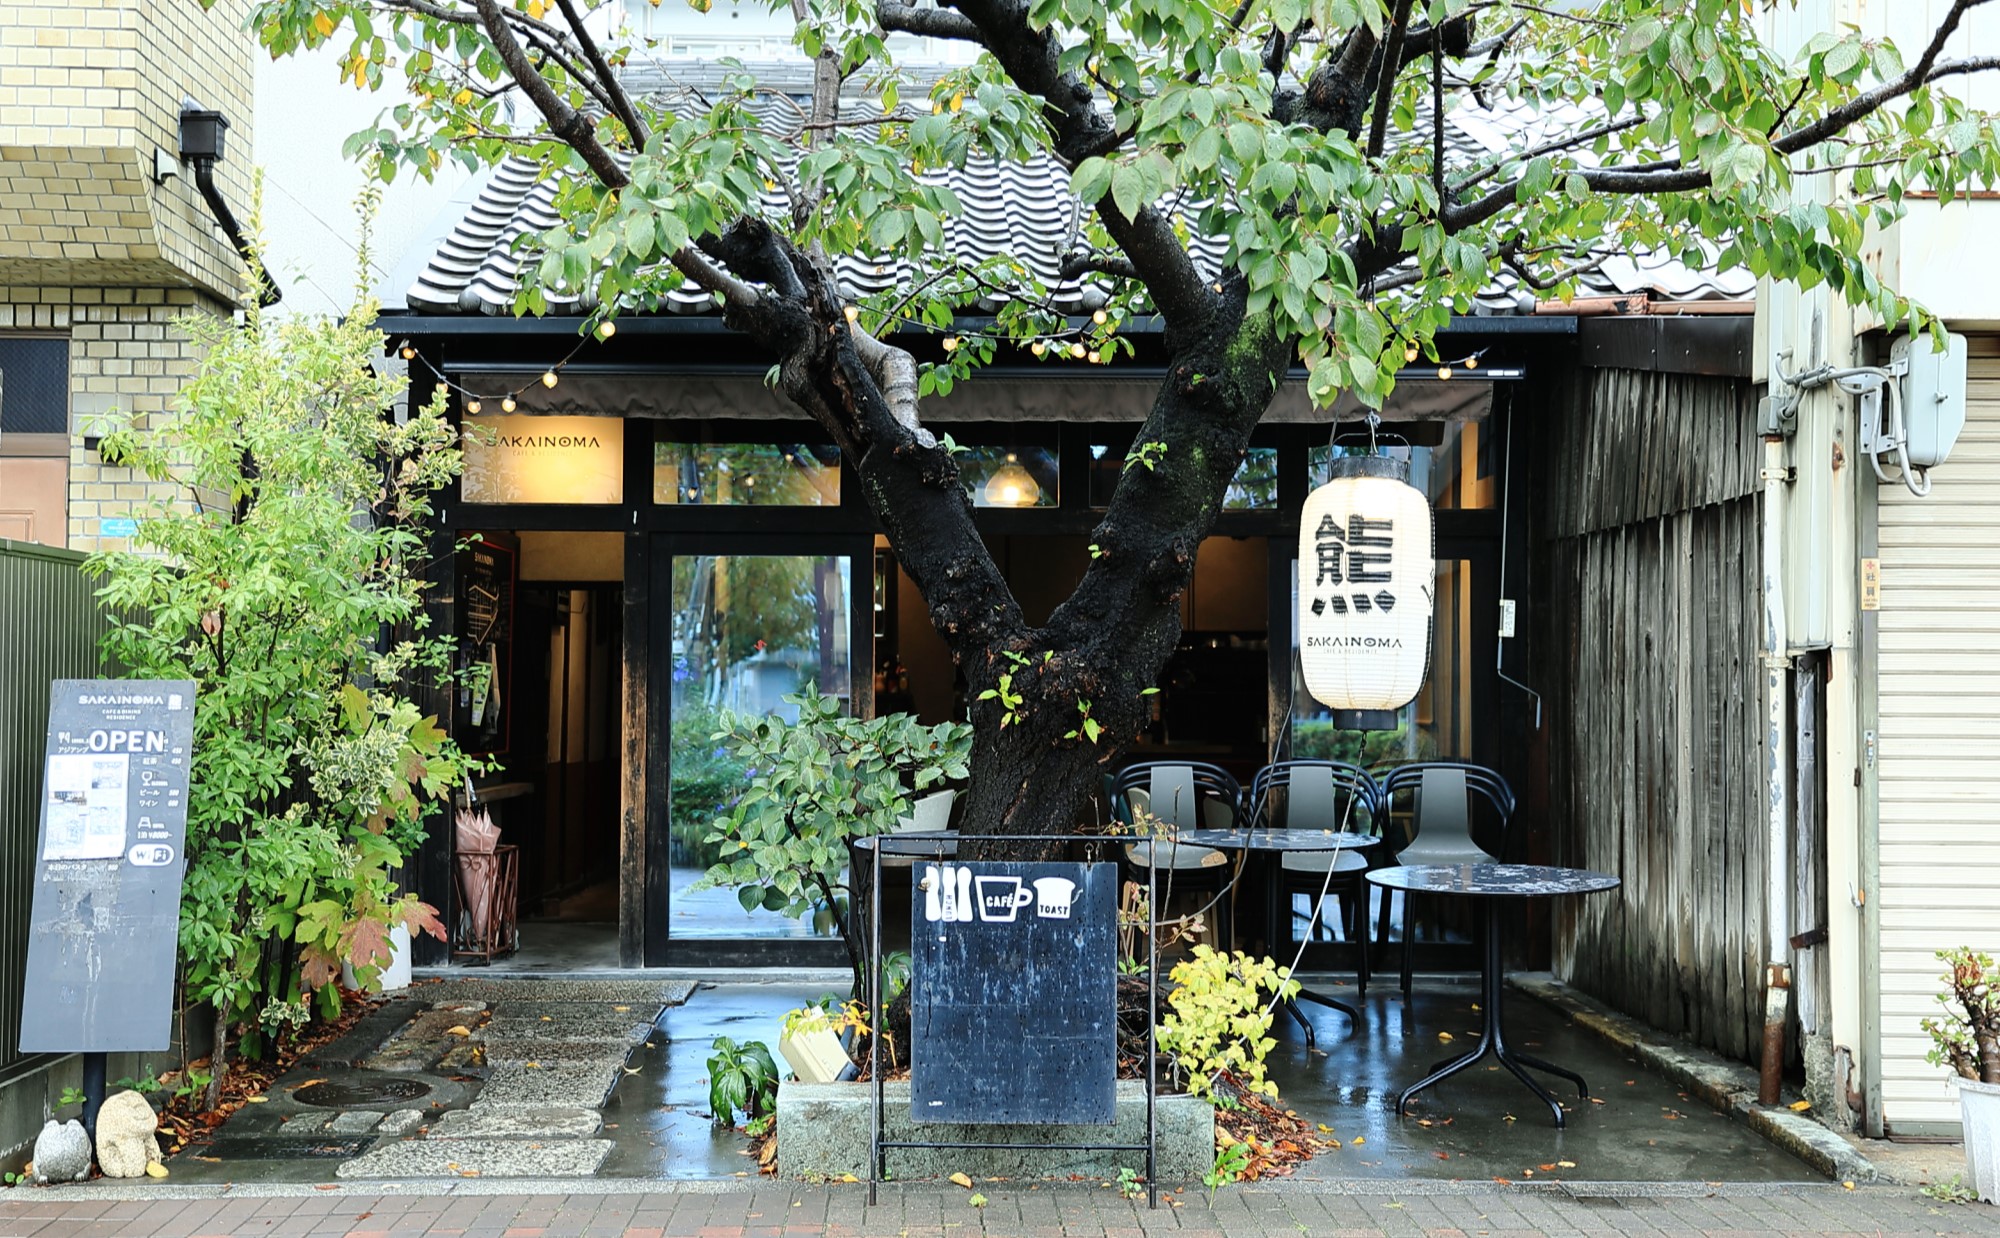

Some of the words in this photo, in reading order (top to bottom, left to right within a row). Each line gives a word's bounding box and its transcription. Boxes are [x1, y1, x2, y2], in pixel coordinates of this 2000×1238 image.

[486, 435, 600, 448] SAKAINOMA
[1307, 636, 1403, 649] SAKAINOMA
[78, 695, 164, 705] SAKAINOMA
[89, 730, 164, 752] OPEN
[140, 789, 160, 797] ビール
[985, 893, 1014, 908] CAFÉ
[1039, 904, 1069, 916] TOAST
